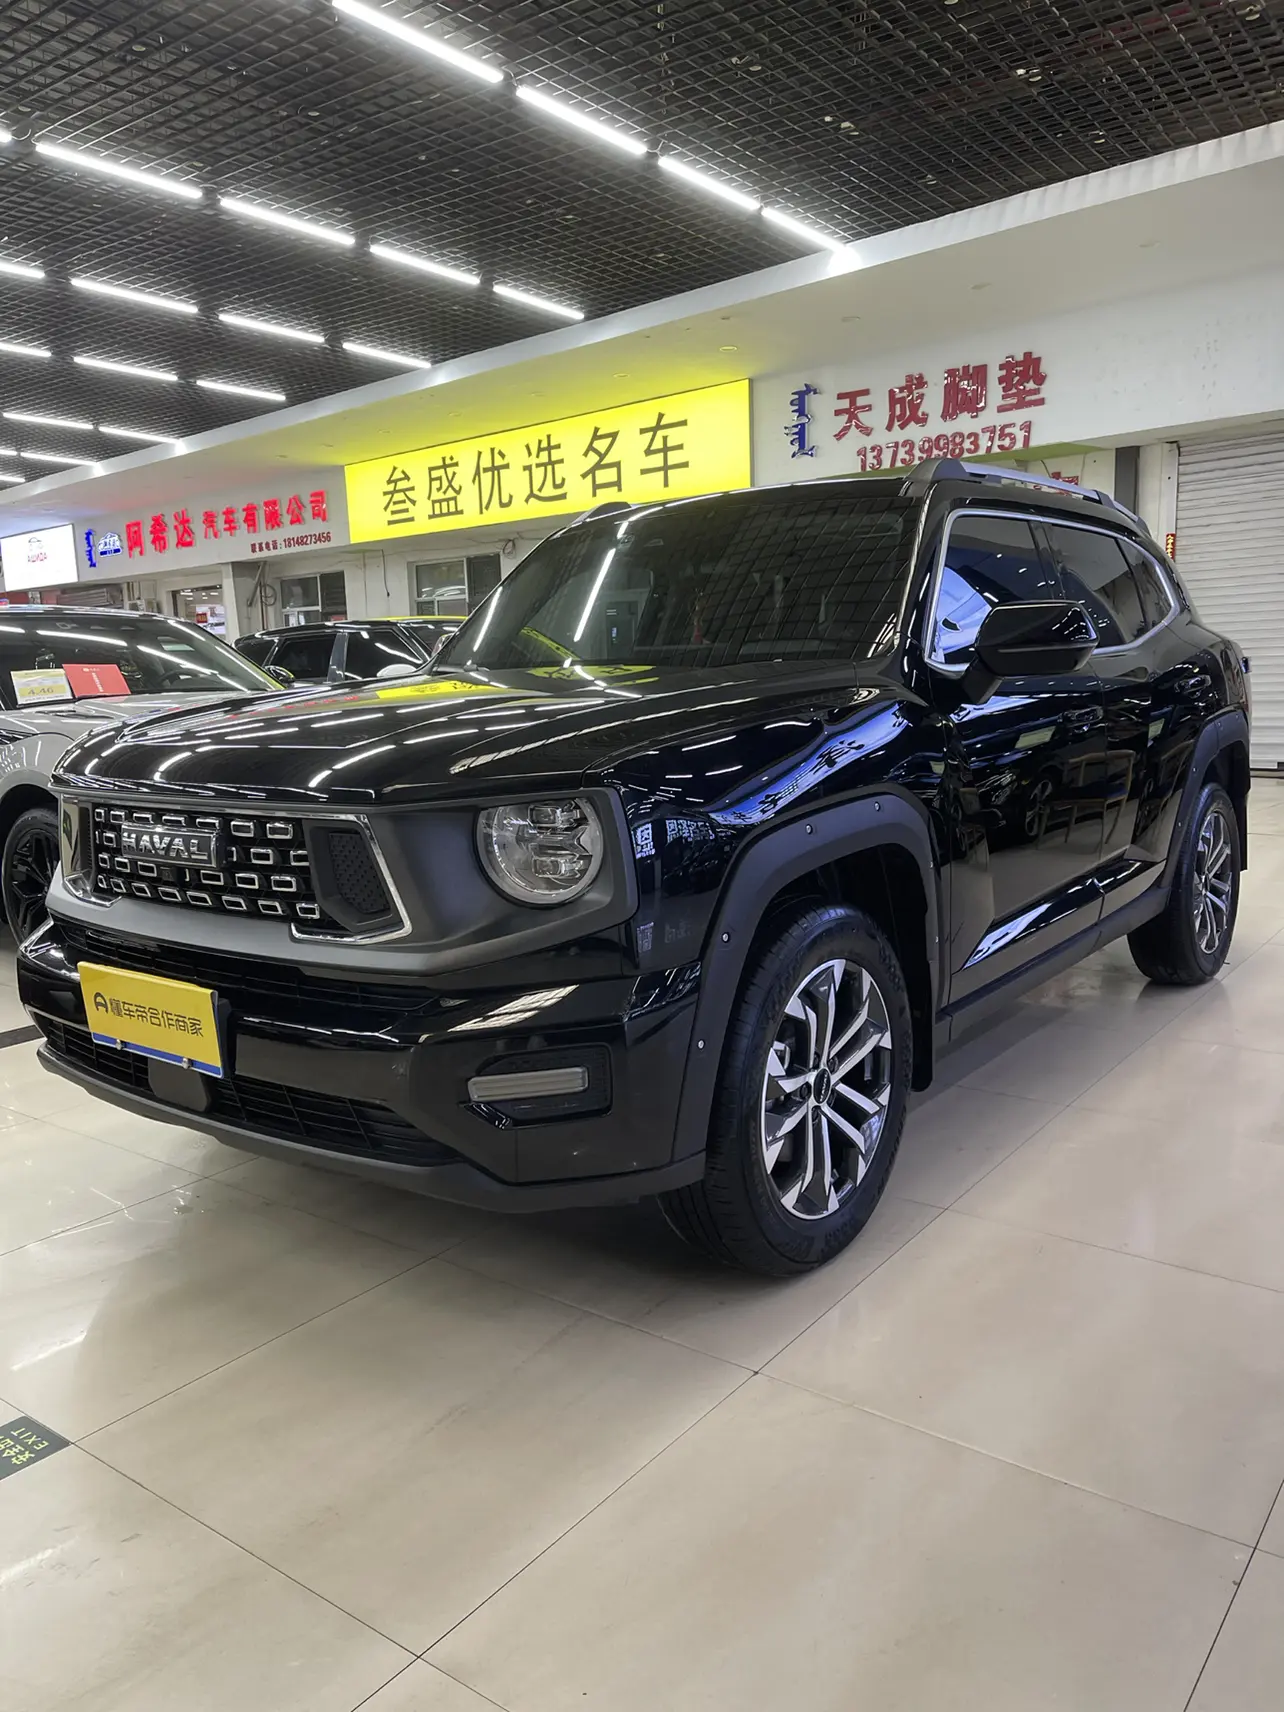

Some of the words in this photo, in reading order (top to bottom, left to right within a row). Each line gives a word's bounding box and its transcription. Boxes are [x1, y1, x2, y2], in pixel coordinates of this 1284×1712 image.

[833, 352, 1047, 441] 天成脚垫
[856, 420, 1032, 472] 13739983751
[382, 411, 689, 526] 叁盛优选名车
[122, 832, 208, 860] HAVAL
[109, 998, 204, 1037] 懂车帝合作商家
[0, 1435, 36, 1465] 安全出
[10, 1427, 50, 1451] EXIT
